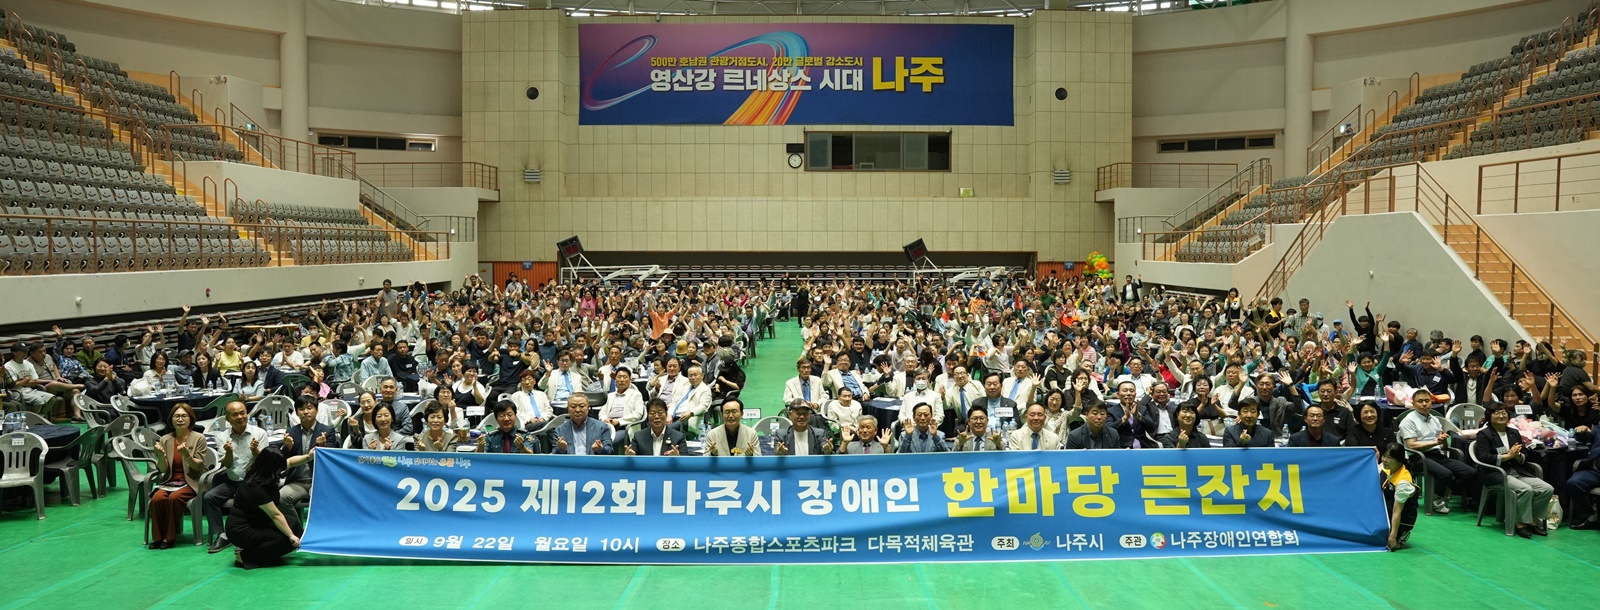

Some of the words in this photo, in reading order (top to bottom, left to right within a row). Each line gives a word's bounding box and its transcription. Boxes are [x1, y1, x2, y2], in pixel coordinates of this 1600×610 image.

[651, 57, 677, 67] 500만
[679, 57, 707, 67] 호남권
[710, 57, 768, 67] 관광거점도시,
[773, 57, 792, 67] 20만
[795, 57, 823, 67] 글로벌
[826, 57, 863, 67] 강소도시
[650, 69, 717, 92] 영산강
[723, 69, 812, 92] 르네상스
[819, 69, 863, 91] 시대
[872, 56, 945, 92] 나주
[396, 477, 506, 512] 2025
[519, 478, 646, 515] 제12회
[662, 480, 781, 516] 나주시
[797, 477, 920, 516] 장애인
[942, 465, 1120, 518] 한마당
[1140, 463, 1304, 515] 큰잔치
[404, 537, 424, 545] 일시
[433, 535, 463, 549] 9월
[472, 536, 515, 551] 22일
[534, 536, 589, 552] 월요일
[600, 537, 640, 553] 10시
[661, 539, 680, 549] 장소
[694, 535, 857, 553] 나주종합스포츠파크
[868, 533, 975, 553] 다목적체육관
[997, 538, 1015, 549] 주최
[1056, 533, 1104, 551] 나주시
[1125, 536, 1142, 546] 주관
[1170, 529, 1300, 549] 나주장애인연합회
